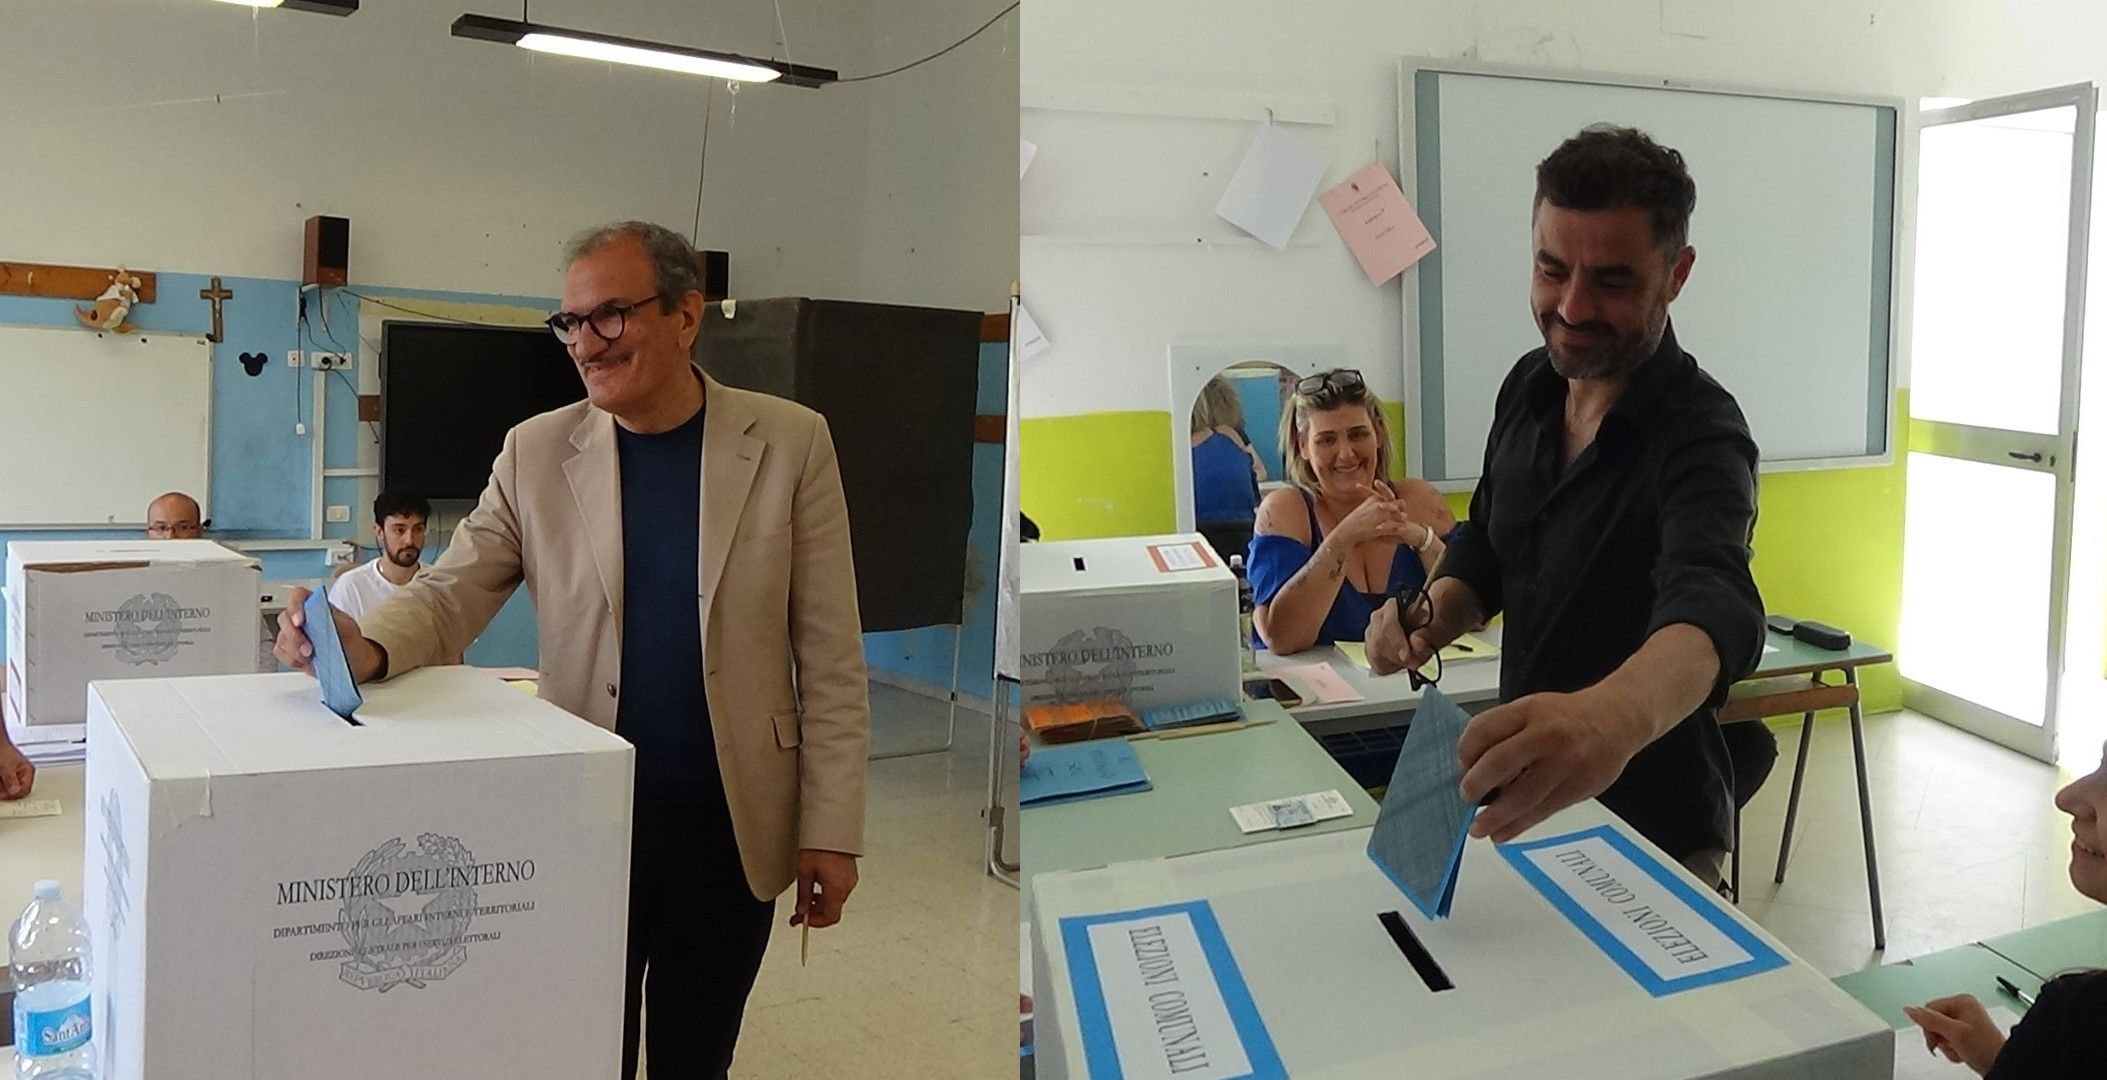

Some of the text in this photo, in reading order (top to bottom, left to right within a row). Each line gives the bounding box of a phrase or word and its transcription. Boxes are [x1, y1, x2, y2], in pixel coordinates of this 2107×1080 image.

[273, 921, 349, 939] DIPARTIMENTO
[473, 901, 535, 916] TERRITORIALI
[276, 859, 535, 905] MINISTERO DELL'INTERNO
[1555, 849, 1709, 964] ELEZIONI COMUNALI
[1128, 925, 1210, 1074] ELEZIONI COMUNALI
